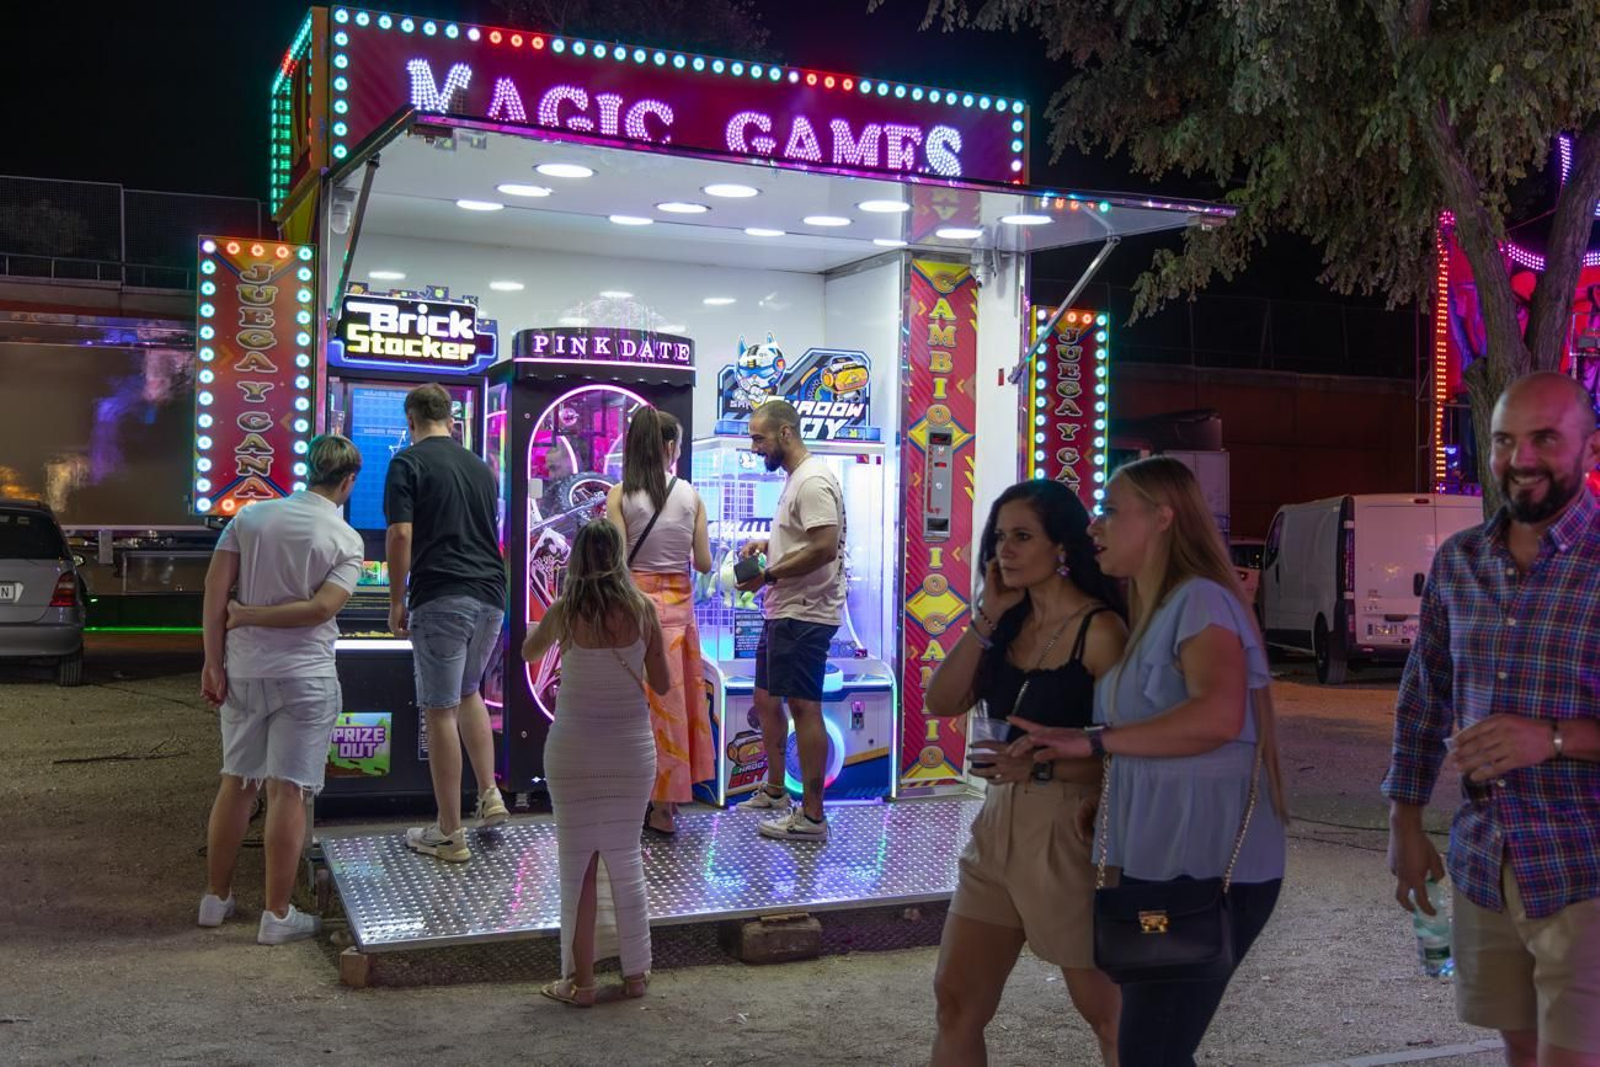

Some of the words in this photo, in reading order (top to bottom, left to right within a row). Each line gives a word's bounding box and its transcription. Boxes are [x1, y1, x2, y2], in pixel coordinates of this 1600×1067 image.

[406, 58, 675, 144] MAGIC
[725, 110, 963, 177] GAMES
[234, 263, 278, 373] JUEGA
[346, 301, 475, 338] Brick
[347, 323, 476, 360] Stocker
[533, 335, 612, 354] PINK
[620, 339, 690, 361] DATE
[926, 272, 957, 425] CAMBIO
[236, 381, 275, 403] Y
[1056, 423, 1080, 441] Y
[918, 611, 948, 768] CAIO
[333, 728, 385, 742] PRIZE
[339, 742, 376, 757] OUT
